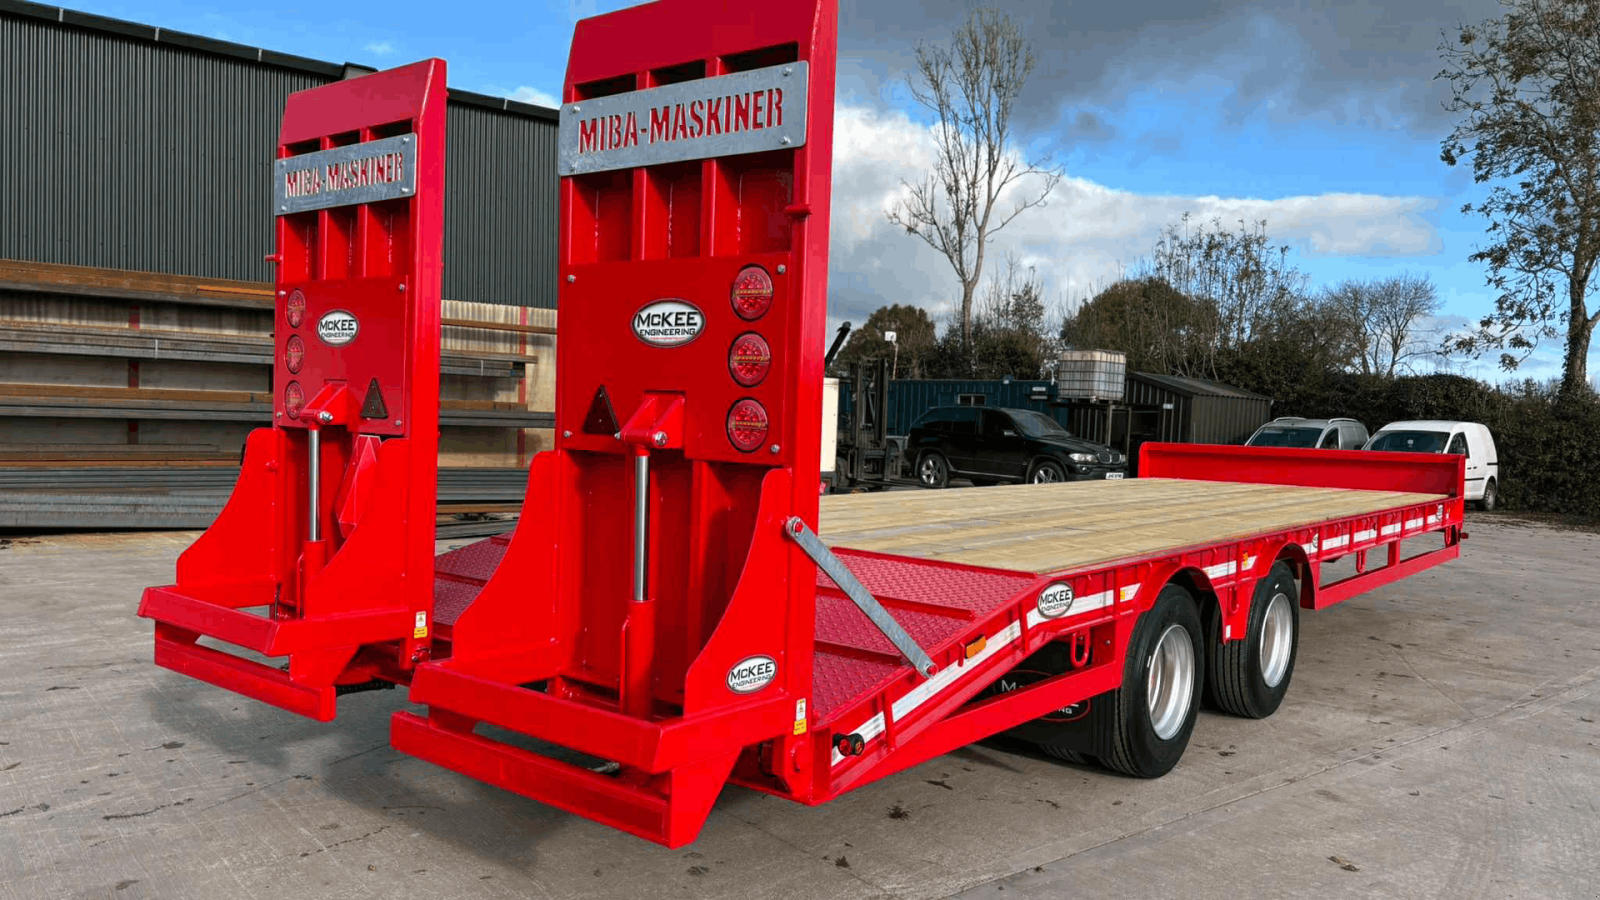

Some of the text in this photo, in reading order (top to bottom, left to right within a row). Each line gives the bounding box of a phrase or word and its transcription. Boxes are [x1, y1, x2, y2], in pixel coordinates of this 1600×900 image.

[578, 88, 783, 154] MIBA-MASKINER
[284, 152, 403, 198] MIBA-MASKINER
[639, 328, 696, 337] ENGINEERING
[732, 674, 772, 688] ENGINEERING
